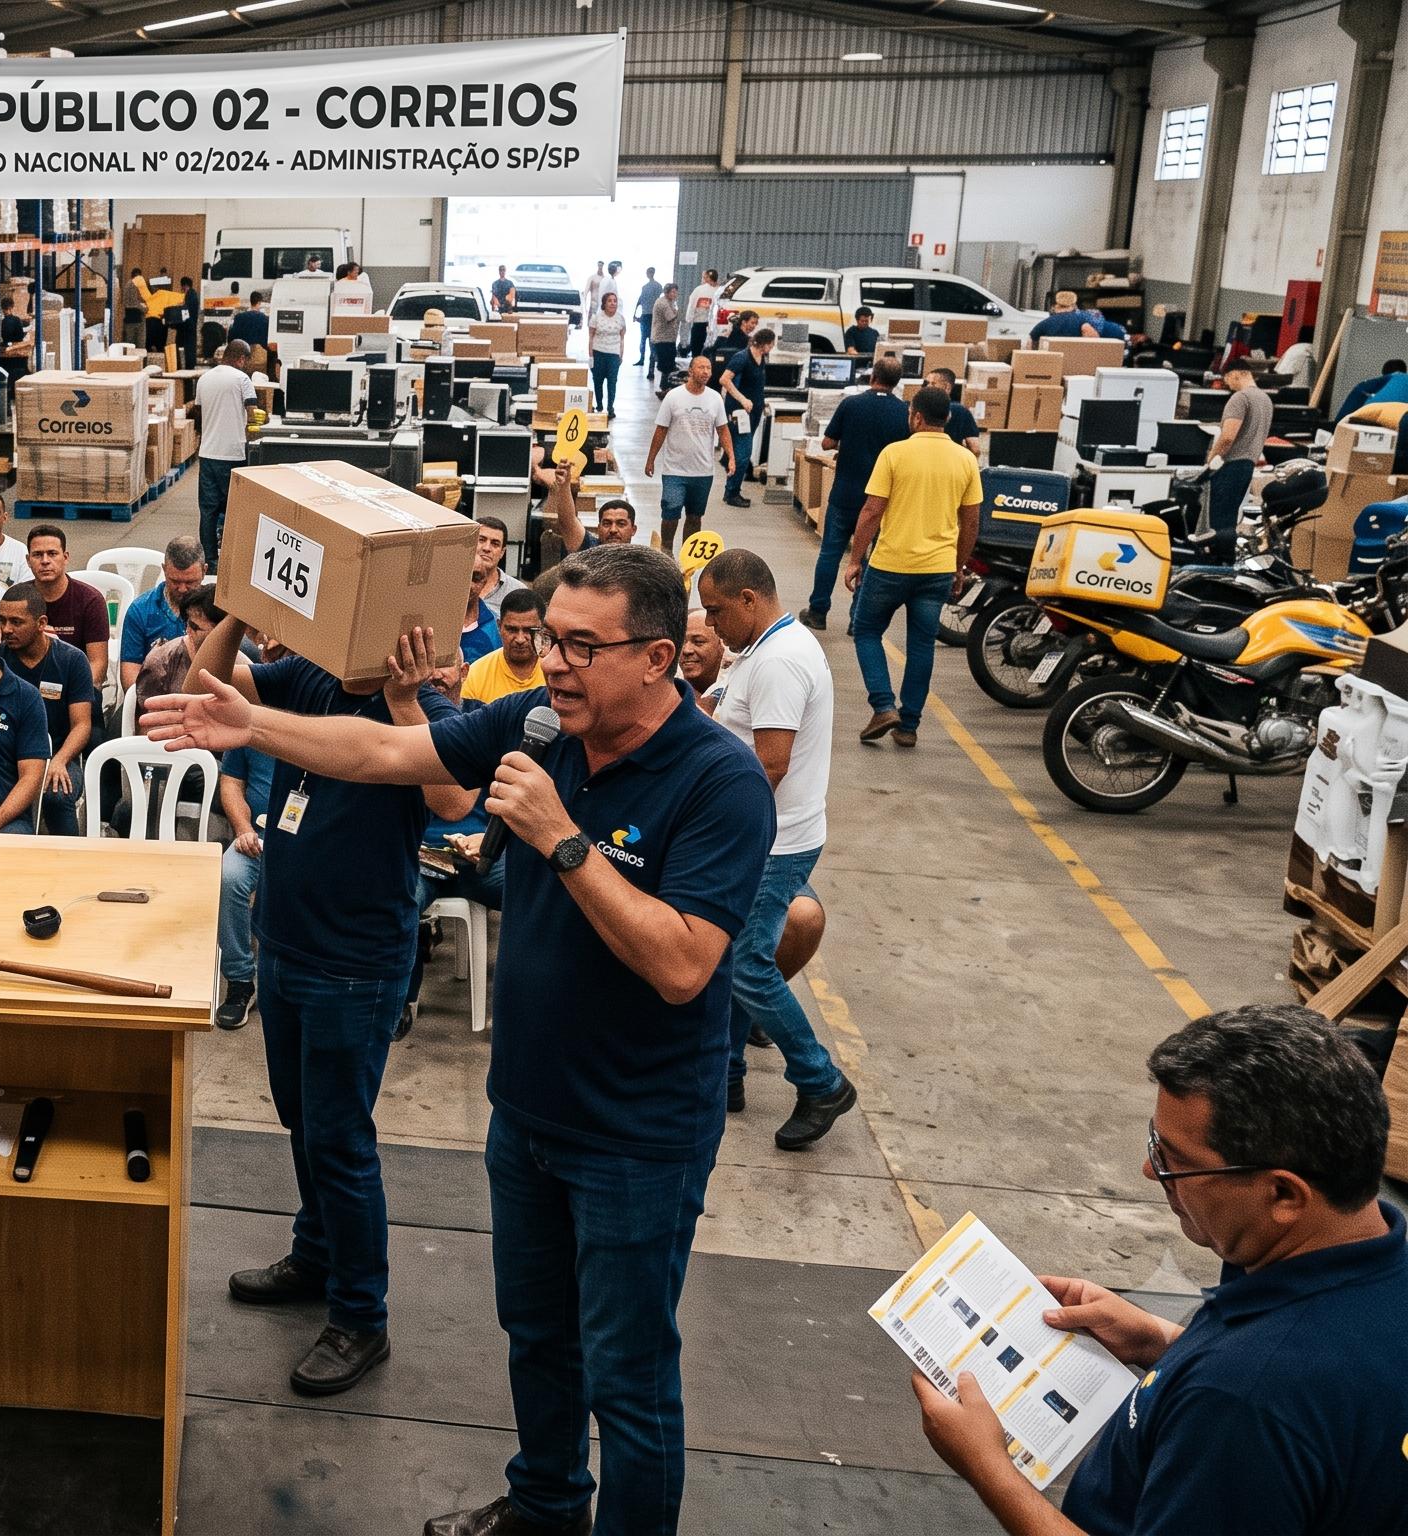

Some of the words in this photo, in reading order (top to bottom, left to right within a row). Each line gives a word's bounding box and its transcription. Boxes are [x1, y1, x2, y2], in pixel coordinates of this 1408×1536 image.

[212, 87, 269, 131] 02
[285, 107, 300, 117] -
[316, 81, 578, 129] CORREIOS
[14, 152, 135, 173] NACIONAL
[142, 151, 168, 172] Nº
[175, 147, 270, 175] 02/2024
[290, 143, 499, 176] ADMINISTRAÇÃO
[506, 143, 580, 171] SP/SP
[38, 417, 113, 435] Correios
[1004, 495, 1059, 512] Correios
[276, 529, 302, 552] LOTE
[687, 538, 719, 560] 133
[264, 546, 310, 598] 145
[1075, 570, 1153, 595] Correios
[596, 841, 645, 868] Correios
